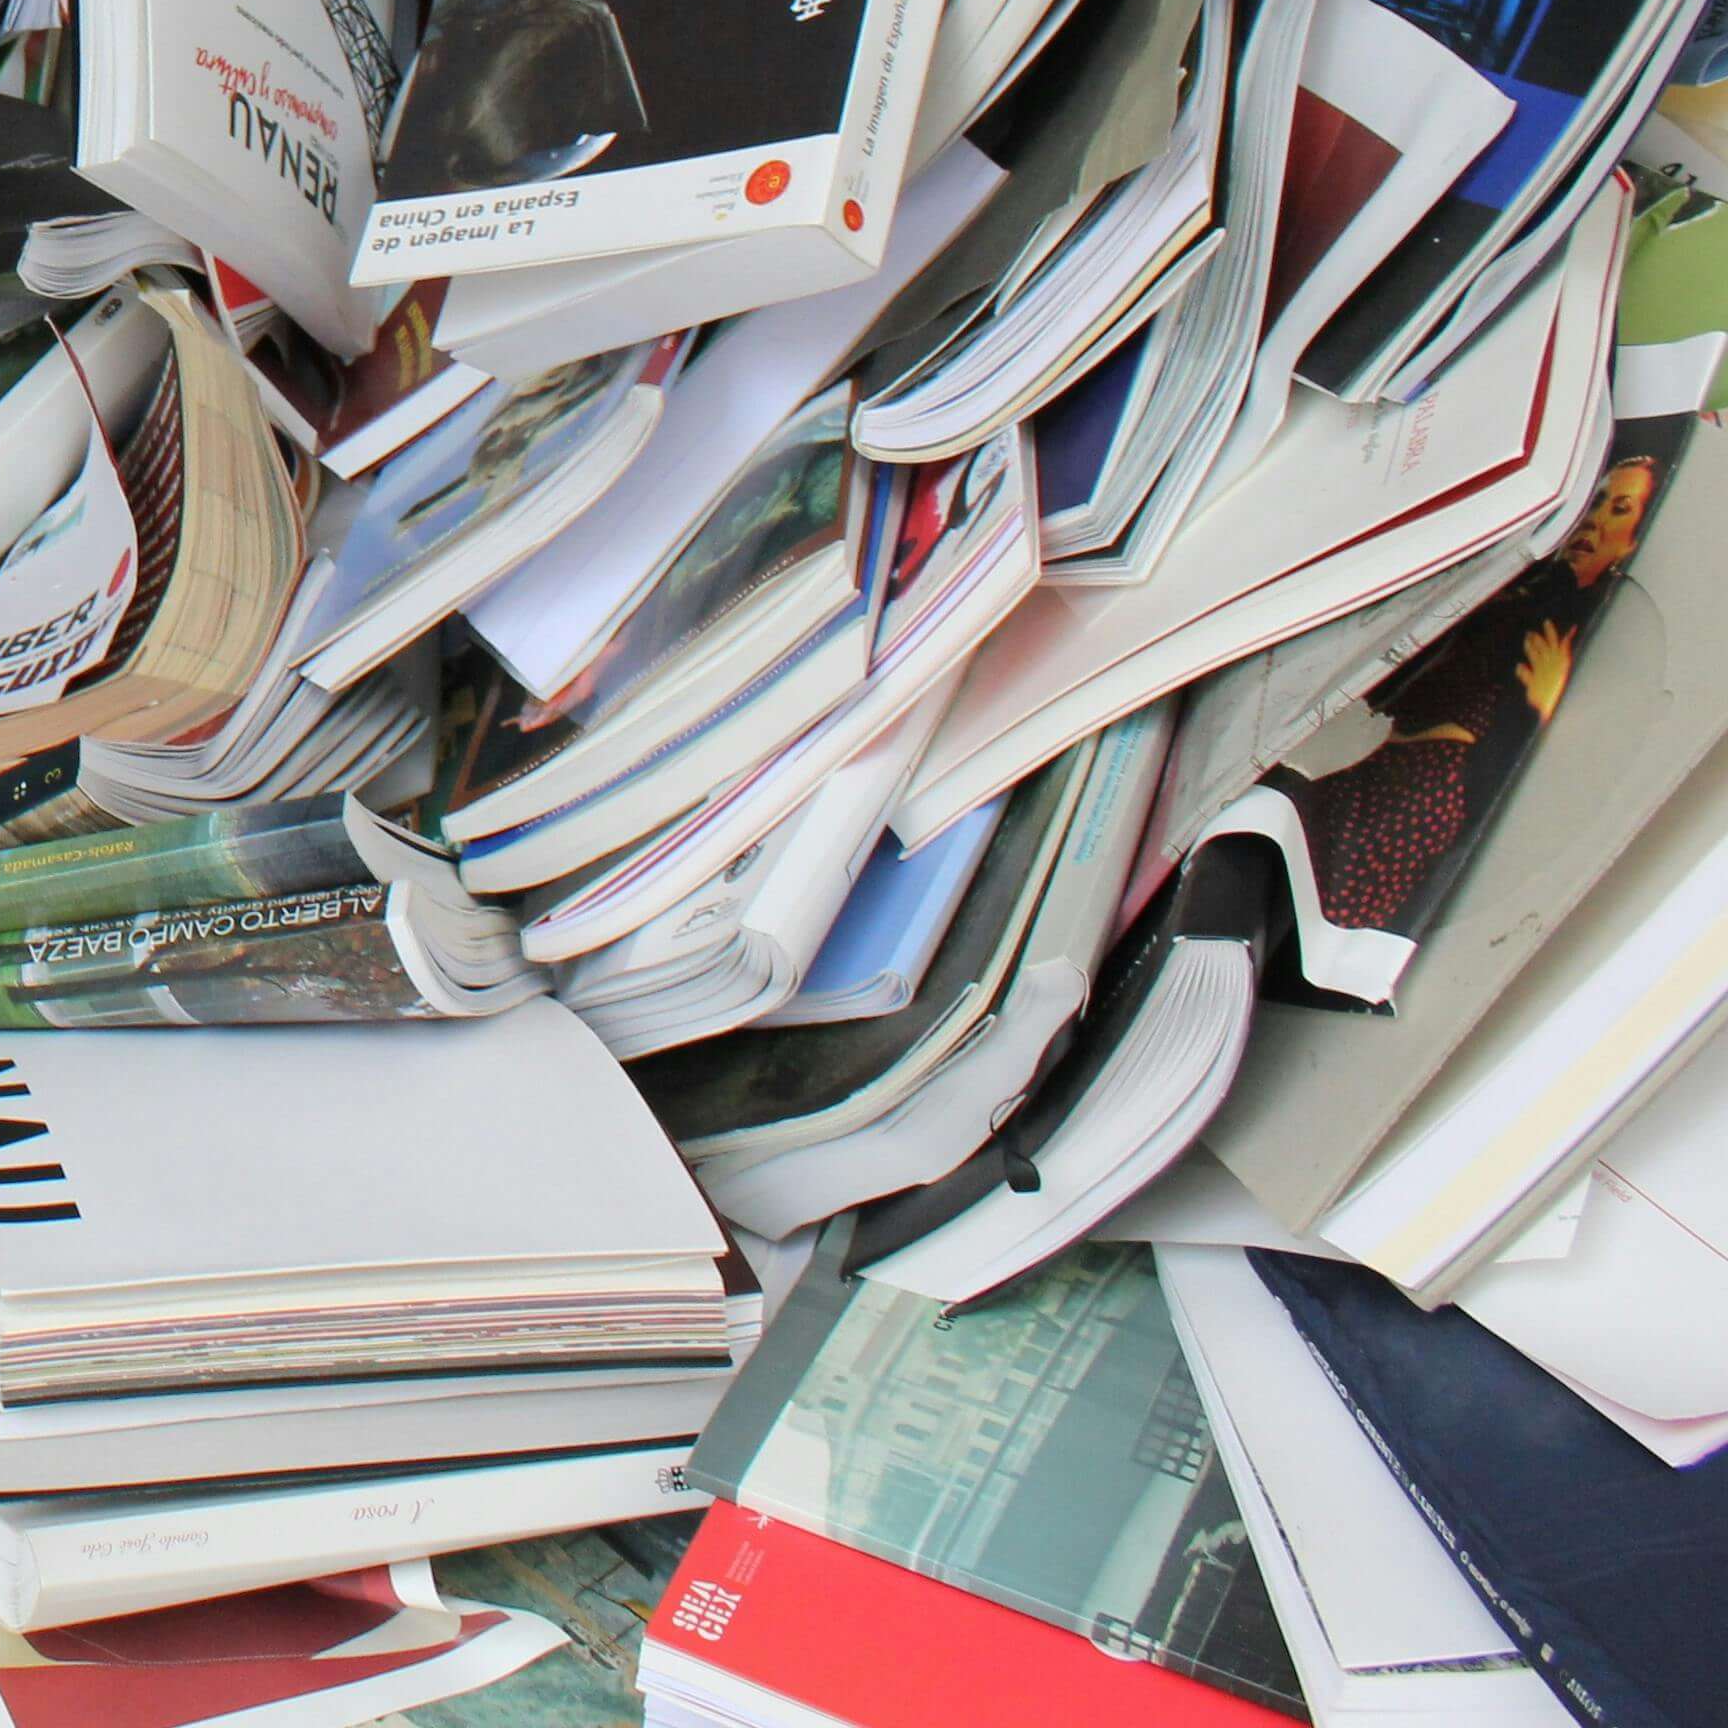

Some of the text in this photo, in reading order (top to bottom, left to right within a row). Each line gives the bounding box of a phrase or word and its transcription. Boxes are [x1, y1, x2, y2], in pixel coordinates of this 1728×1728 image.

[194, 45, 258, 99] cultura
[882, 51, 896, 75] de
[867, 76, 891, 132] Imagen
[228, 91, 339, 226] RENAU
[862, 130, 880, 158] La
[378, 188, 580, 229] España en China
[370, 219, 535, 253] La Imagen de
[29, 894, 383, 965] ALBERTO CAMPO BAEZA
[351, 1503, 400, 1521] rosa
[117, 1534, 156, 1560] José
[156, 1530, 211, 1551] Camilo
[672, 1578, 716, 1634] SEA
[696, 1586, 743, 1642] CEX
